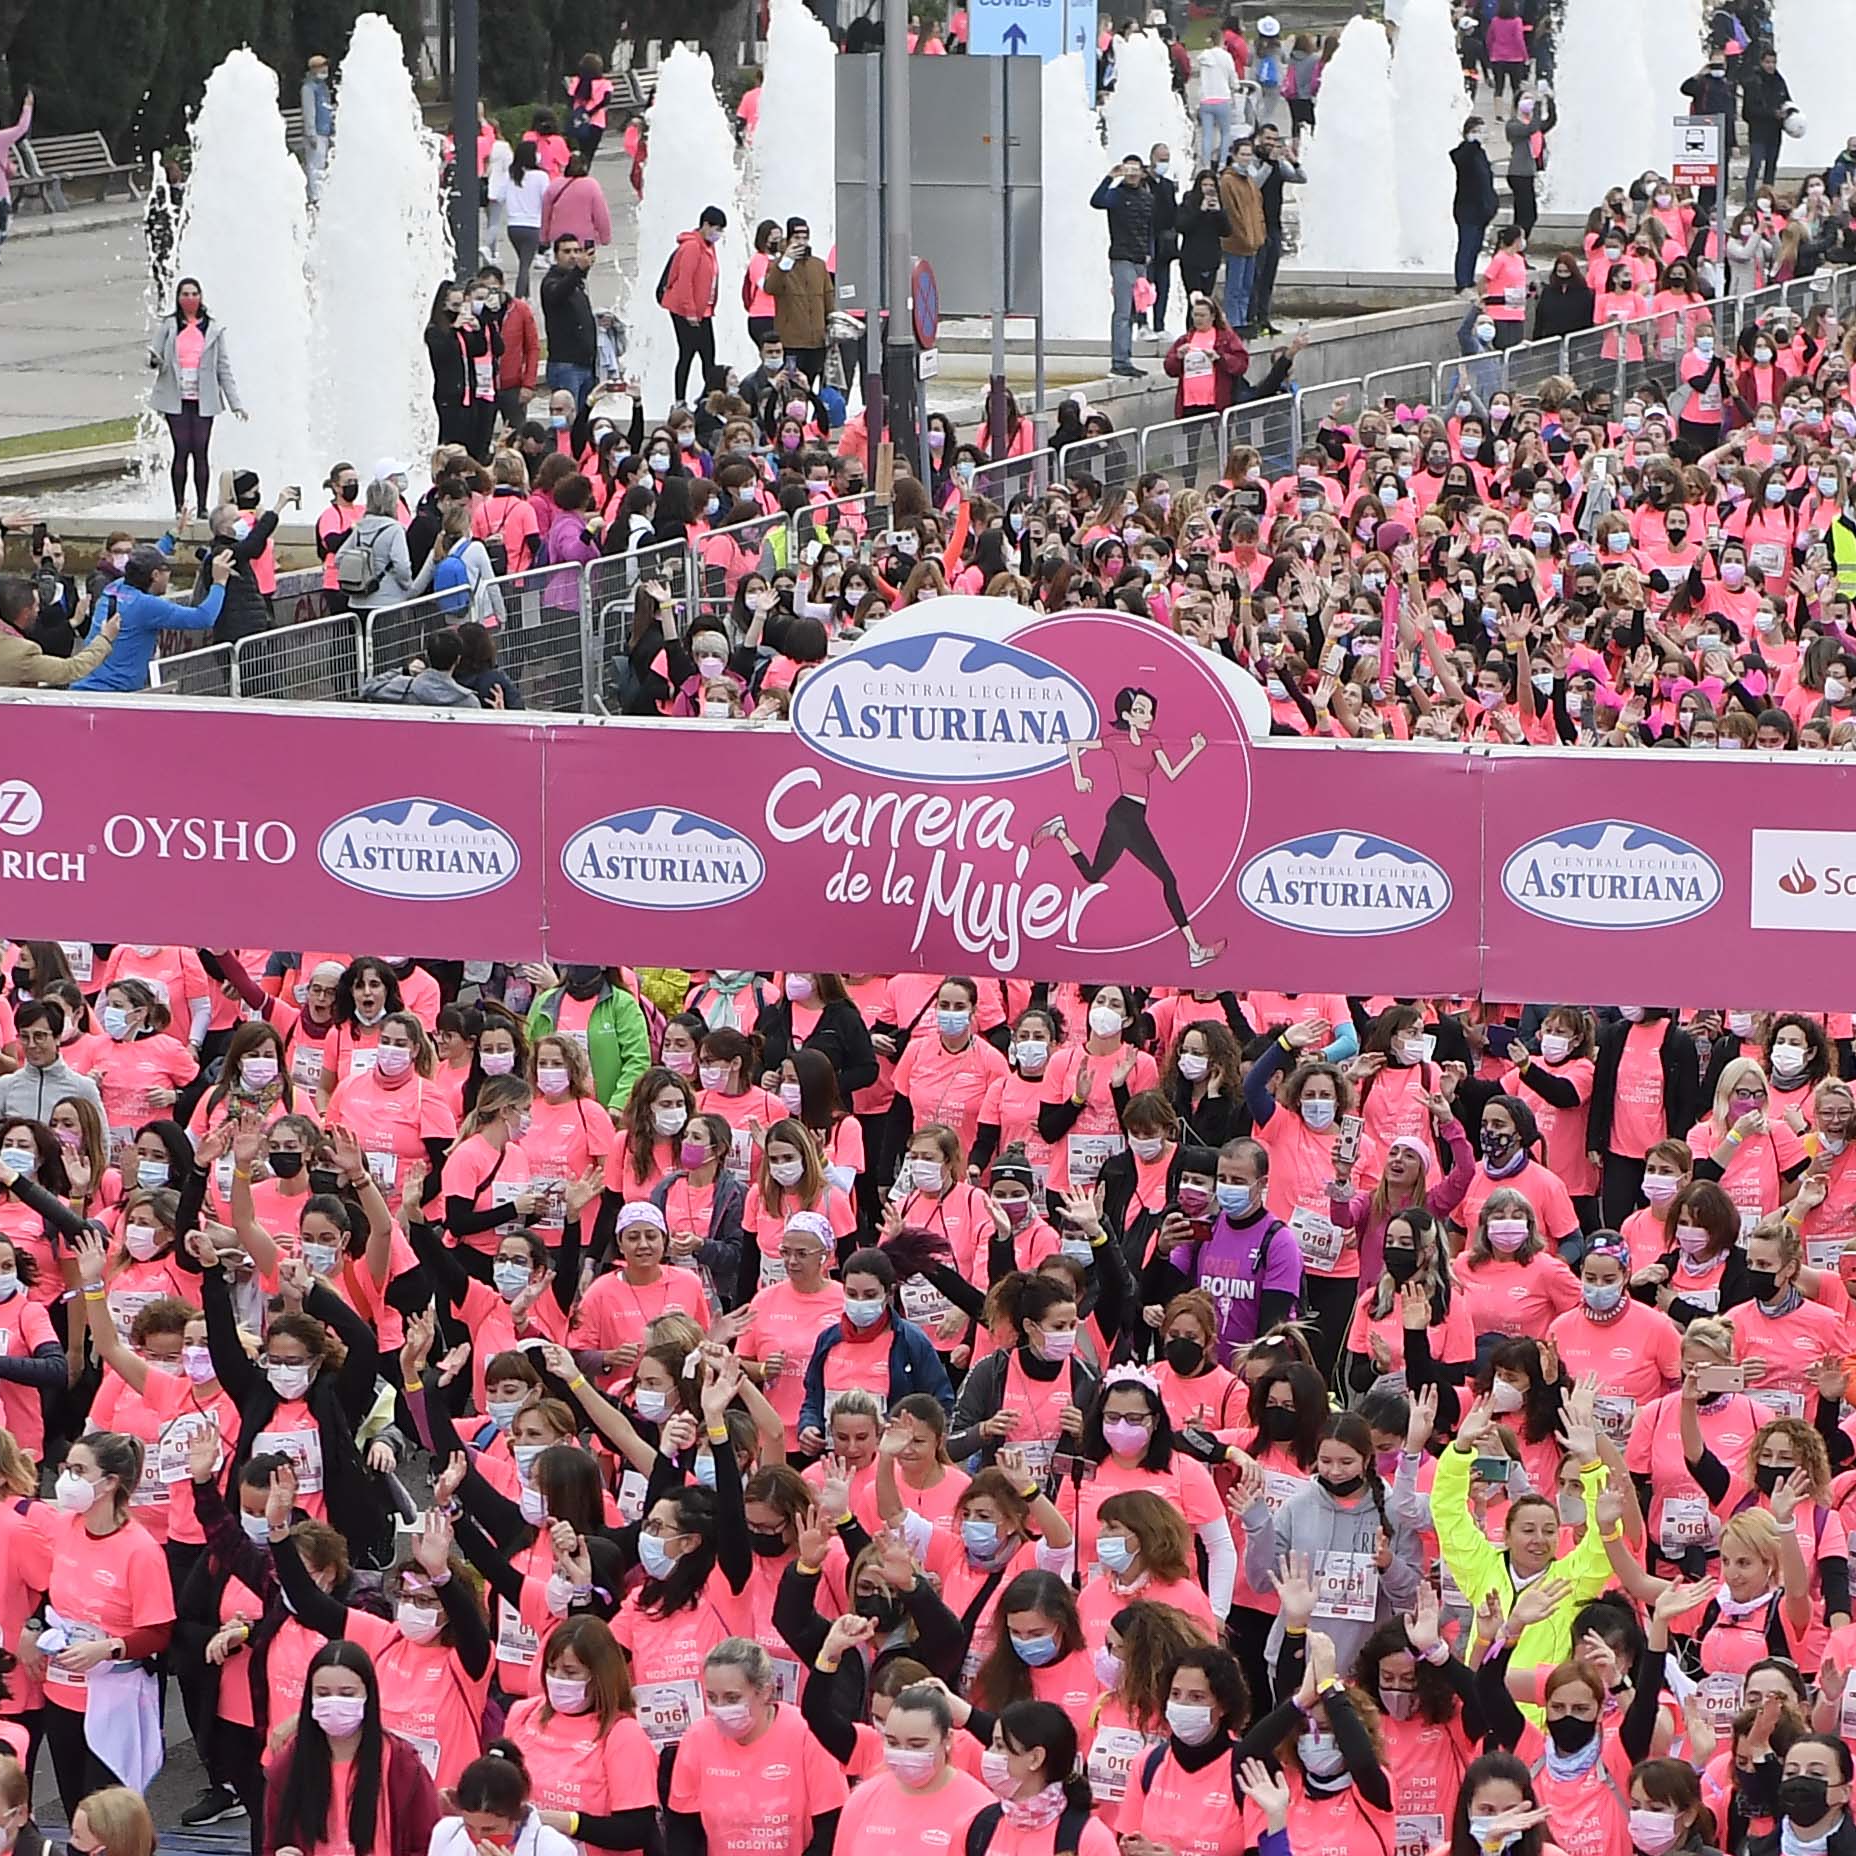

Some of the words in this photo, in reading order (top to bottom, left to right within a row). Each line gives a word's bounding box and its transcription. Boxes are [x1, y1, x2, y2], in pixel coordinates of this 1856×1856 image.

[862, 682, 959, 697] CENTRAL
[968, 685, 1063, 701] LECHERA
[815, 684, 1072, 744] ASTURIANA
[766, 766, 1015, 852] Carrera
[103, 814, 296, 864] OYSHO
[333, 833, 503, 875] ASTURIANA
[568, 842, 748, 884] ASTURIANA
[1552, 856, 1621, 867] CENTRAL
[1627, 858, 1698, 870] LECHERA
[1286, 865, 1352, 877] CENTRAL
[1357, 866, 1429, 880] LECHERA
[1518, 859, 1703, 901] ASTURIANA
[1254, 866, 1434, 909] ASTURIANA
[825, 850, 871, 903] de
[883, 850, 914, 905] la
[909, 845, 1109, 971] Mujer
[1302, 1232, 1326, 1247] 016
[1678, 1523, 1704, 1534] 016
[1707, 1698, 1733, 1709] 016
[655, 1709, 682, 1724] 016
[764, 1815, 788, 1824] POR
[752, 1827, 789, 1836] TODAS
[728, 1840, 788, 1850] NOSOTRAS
